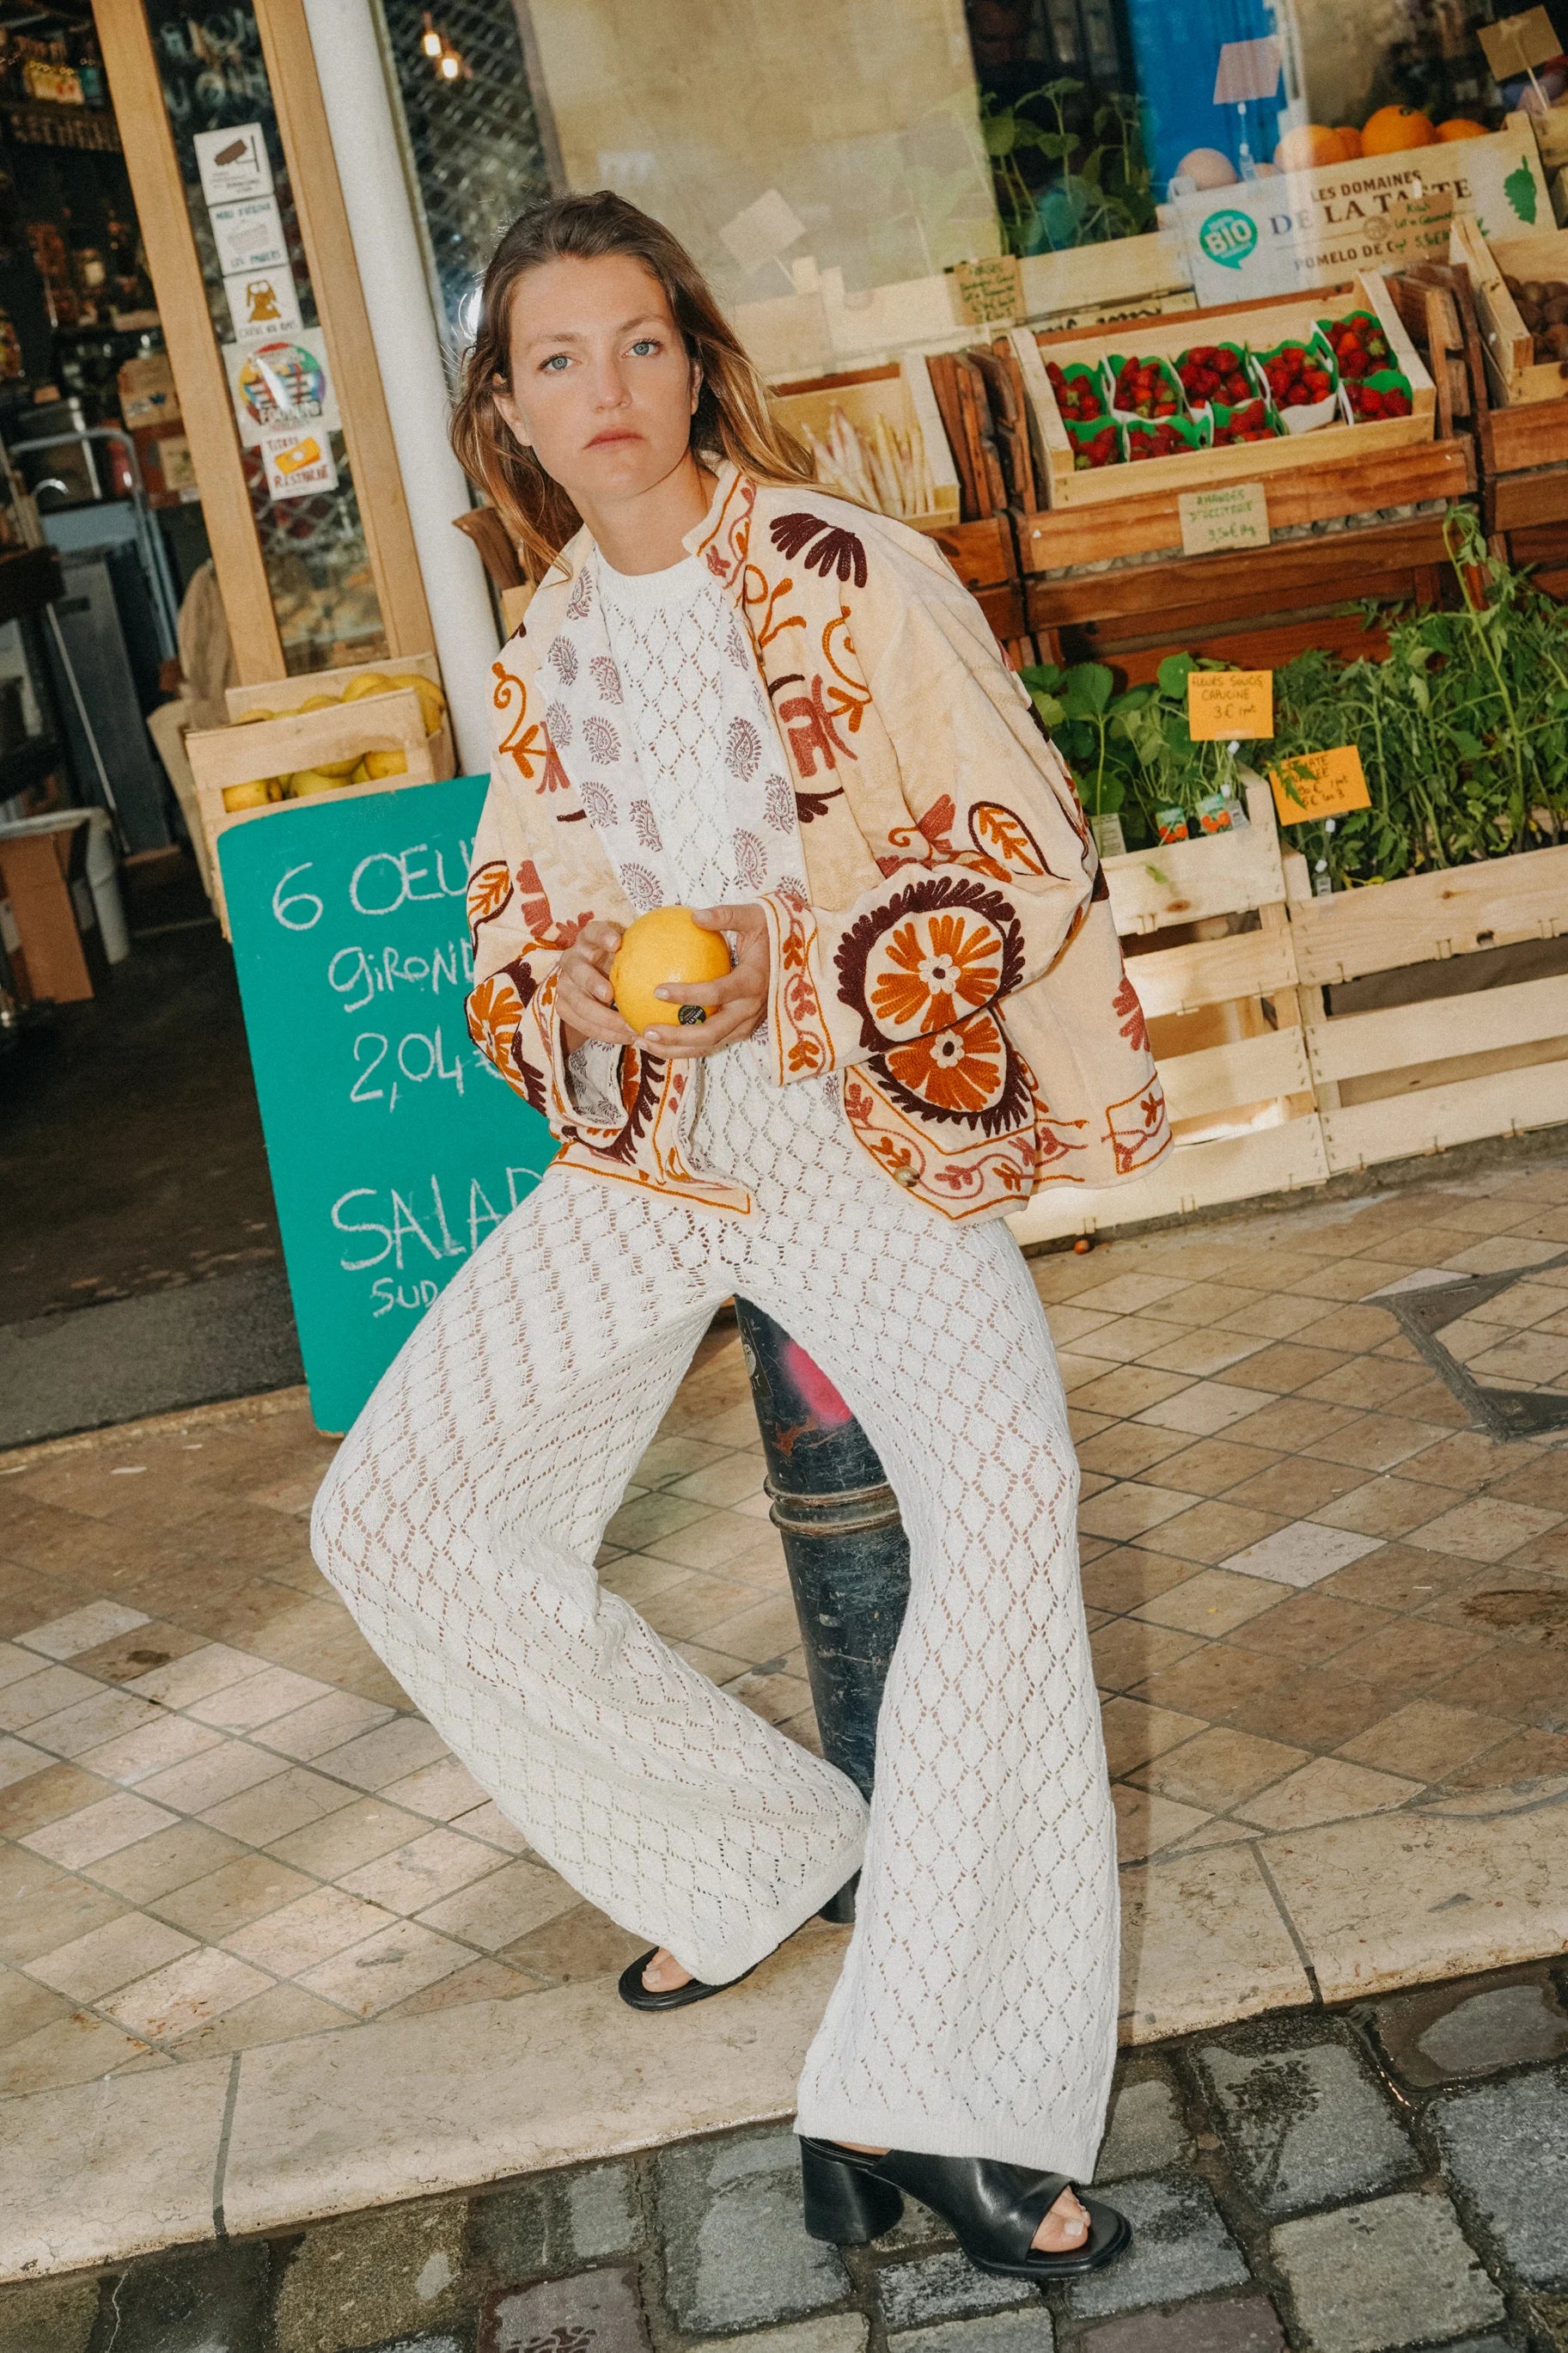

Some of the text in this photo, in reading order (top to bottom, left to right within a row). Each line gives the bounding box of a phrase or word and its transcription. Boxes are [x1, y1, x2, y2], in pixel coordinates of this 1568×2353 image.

[1340, 169, 1422, 197] DOMAINES
[1324, 200, 1365, 224] LA
[1205, 217, 1252, 256] BIO
[1294, 247, 1358, 272] POMELO
[1362, 242, 1382, 258] DE
[272, 861, 324, 931] 6
